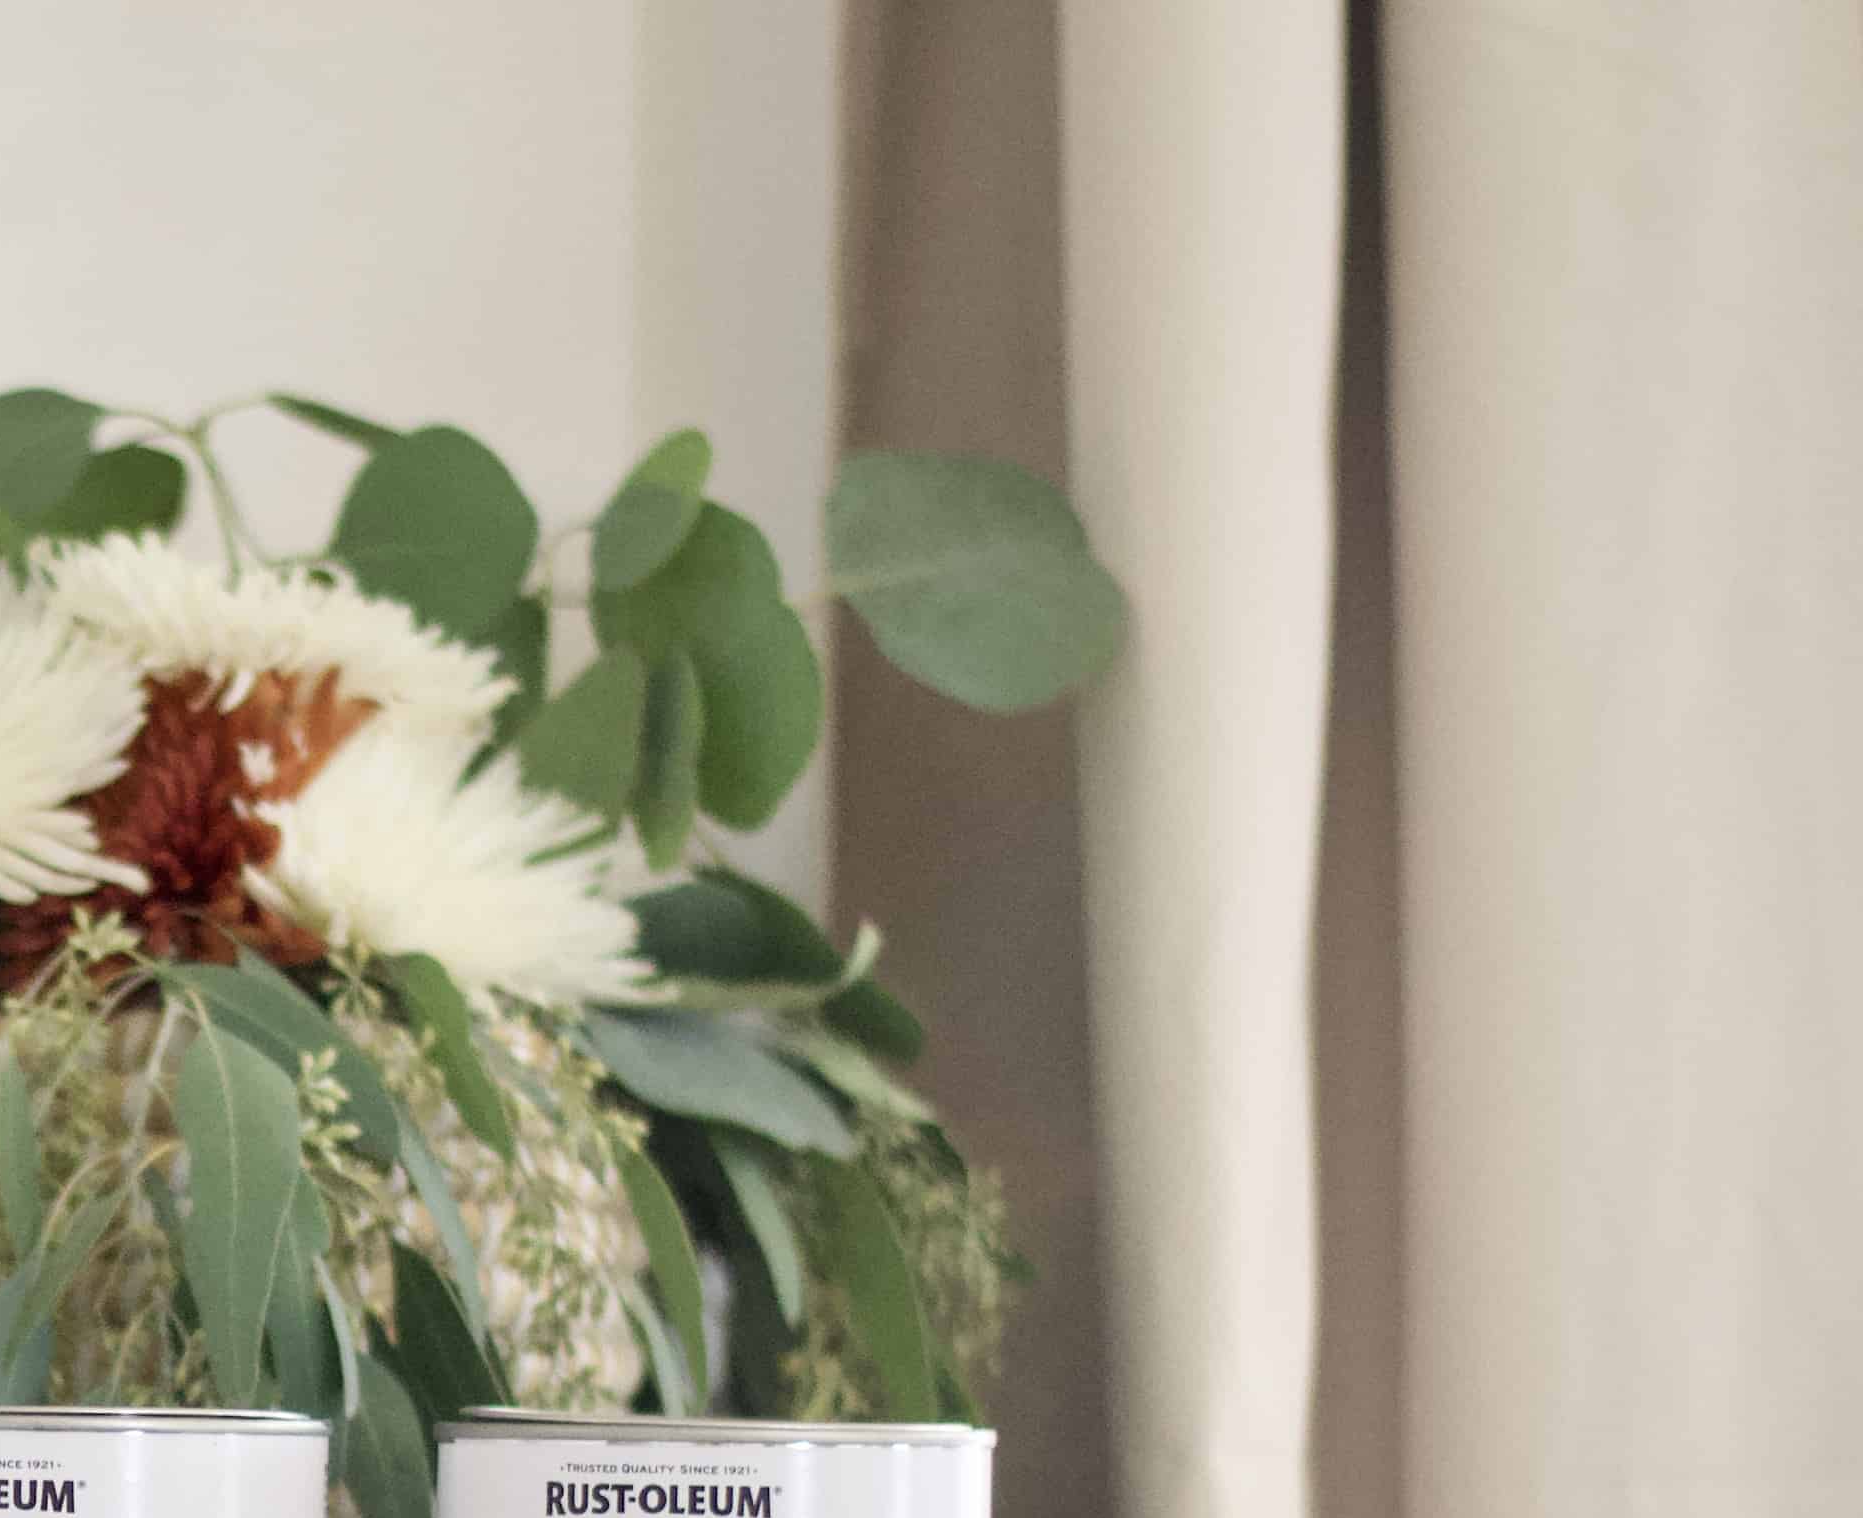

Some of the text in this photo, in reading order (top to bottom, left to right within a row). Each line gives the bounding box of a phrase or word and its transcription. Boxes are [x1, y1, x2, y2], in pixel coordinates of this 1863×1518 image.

[26, 1460, 55, 1470] 1921
[566, 1463, 617, 1474] TRUSTED
[621, 1463, 675, 1475] QUALITY
[680, 1464, 718, 1475] SINCE
[546, 1481, 771, 1518] RUST-OLEUM
